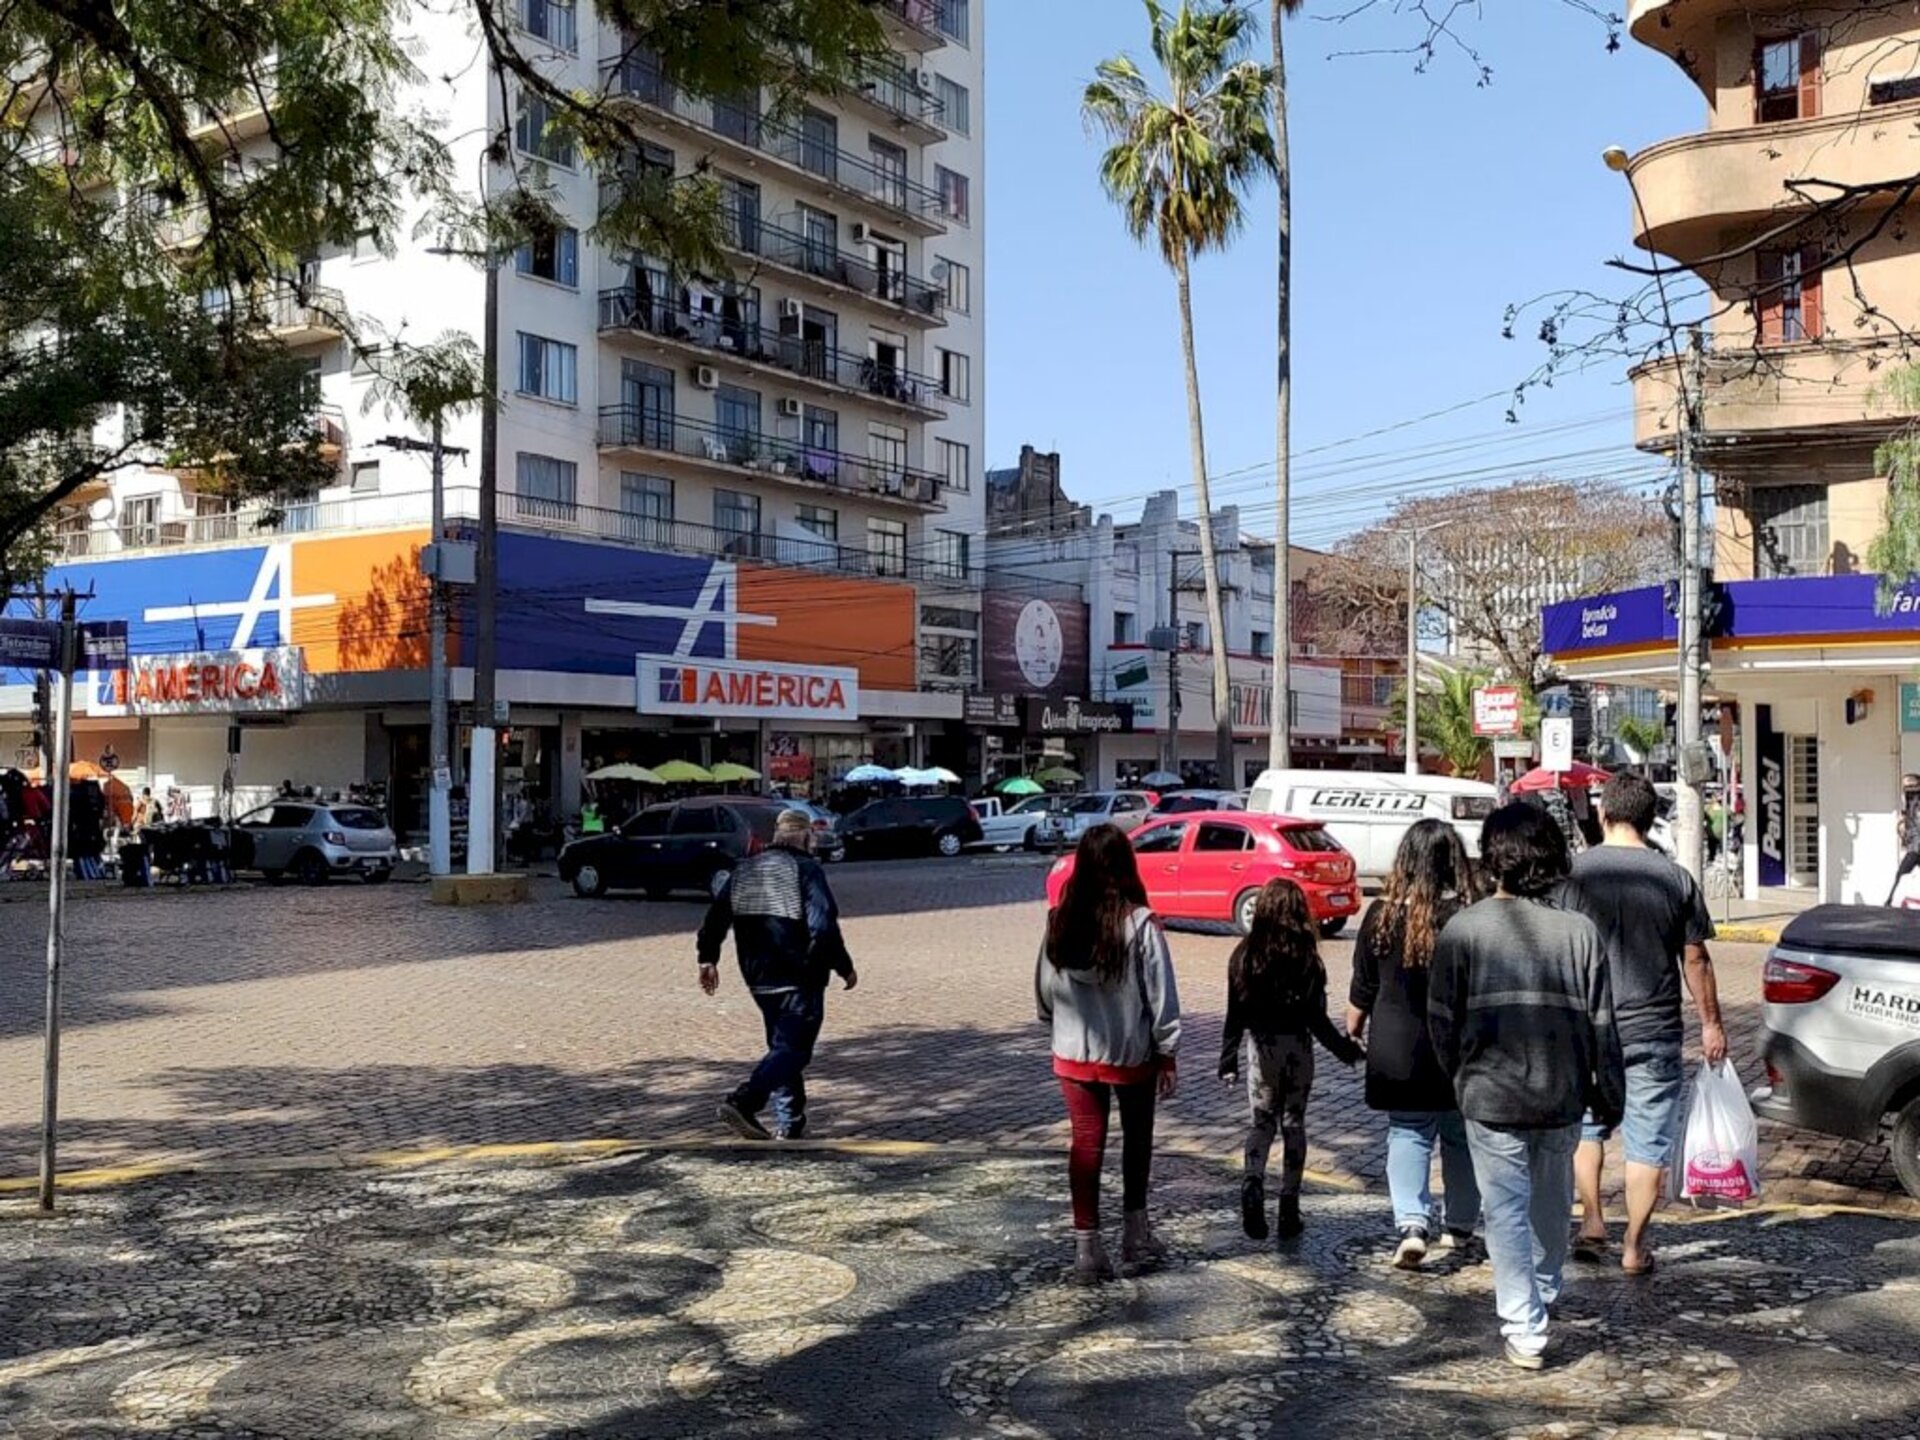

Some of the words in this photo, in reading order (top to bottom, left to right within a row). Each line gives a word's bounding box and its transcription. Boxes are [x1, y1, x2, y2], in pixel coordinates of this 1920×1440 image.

[135, 662, 280, 703] AMÉRICA
[703, 670, 846, 709] AMÉRICA
[1854, 986, 1920, 1014] HARD
